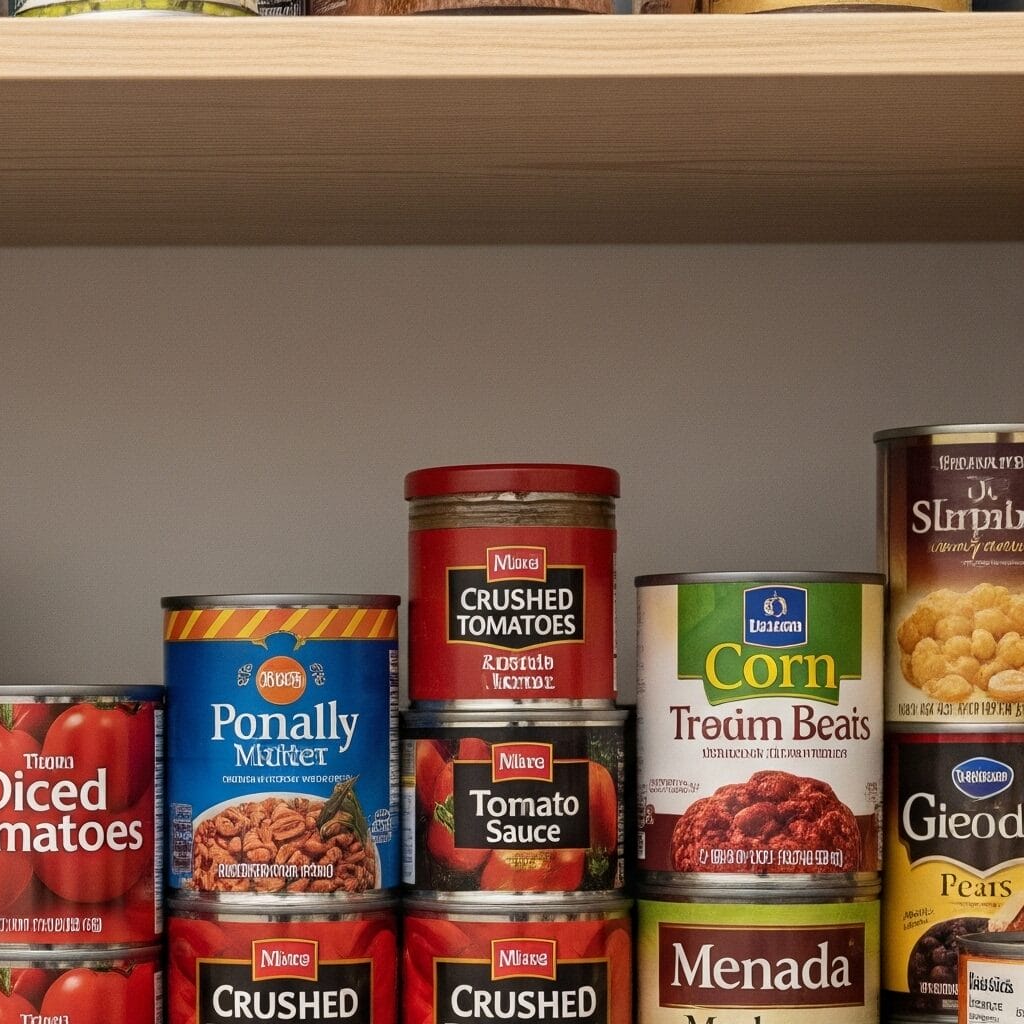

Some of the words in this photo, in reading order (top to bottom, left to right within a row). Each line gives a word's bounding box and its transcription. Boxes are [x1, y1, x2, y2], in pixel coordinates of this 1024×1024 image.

[460, 588, 573, 611] CRUSHED
[456, 614, 576, 636] TOMATOES
[705, 643, 838, 690] Corn
[210, 700, 359, 753] Ponally
[469, 789, 580, 817] Tomato
[486, 820, 561, 843] Sauce
[671, 942, 852, 991] Menada
[213, 984, 359, 1020] CRUSHED
[451, 984, 597, 1020] CRUSHED
